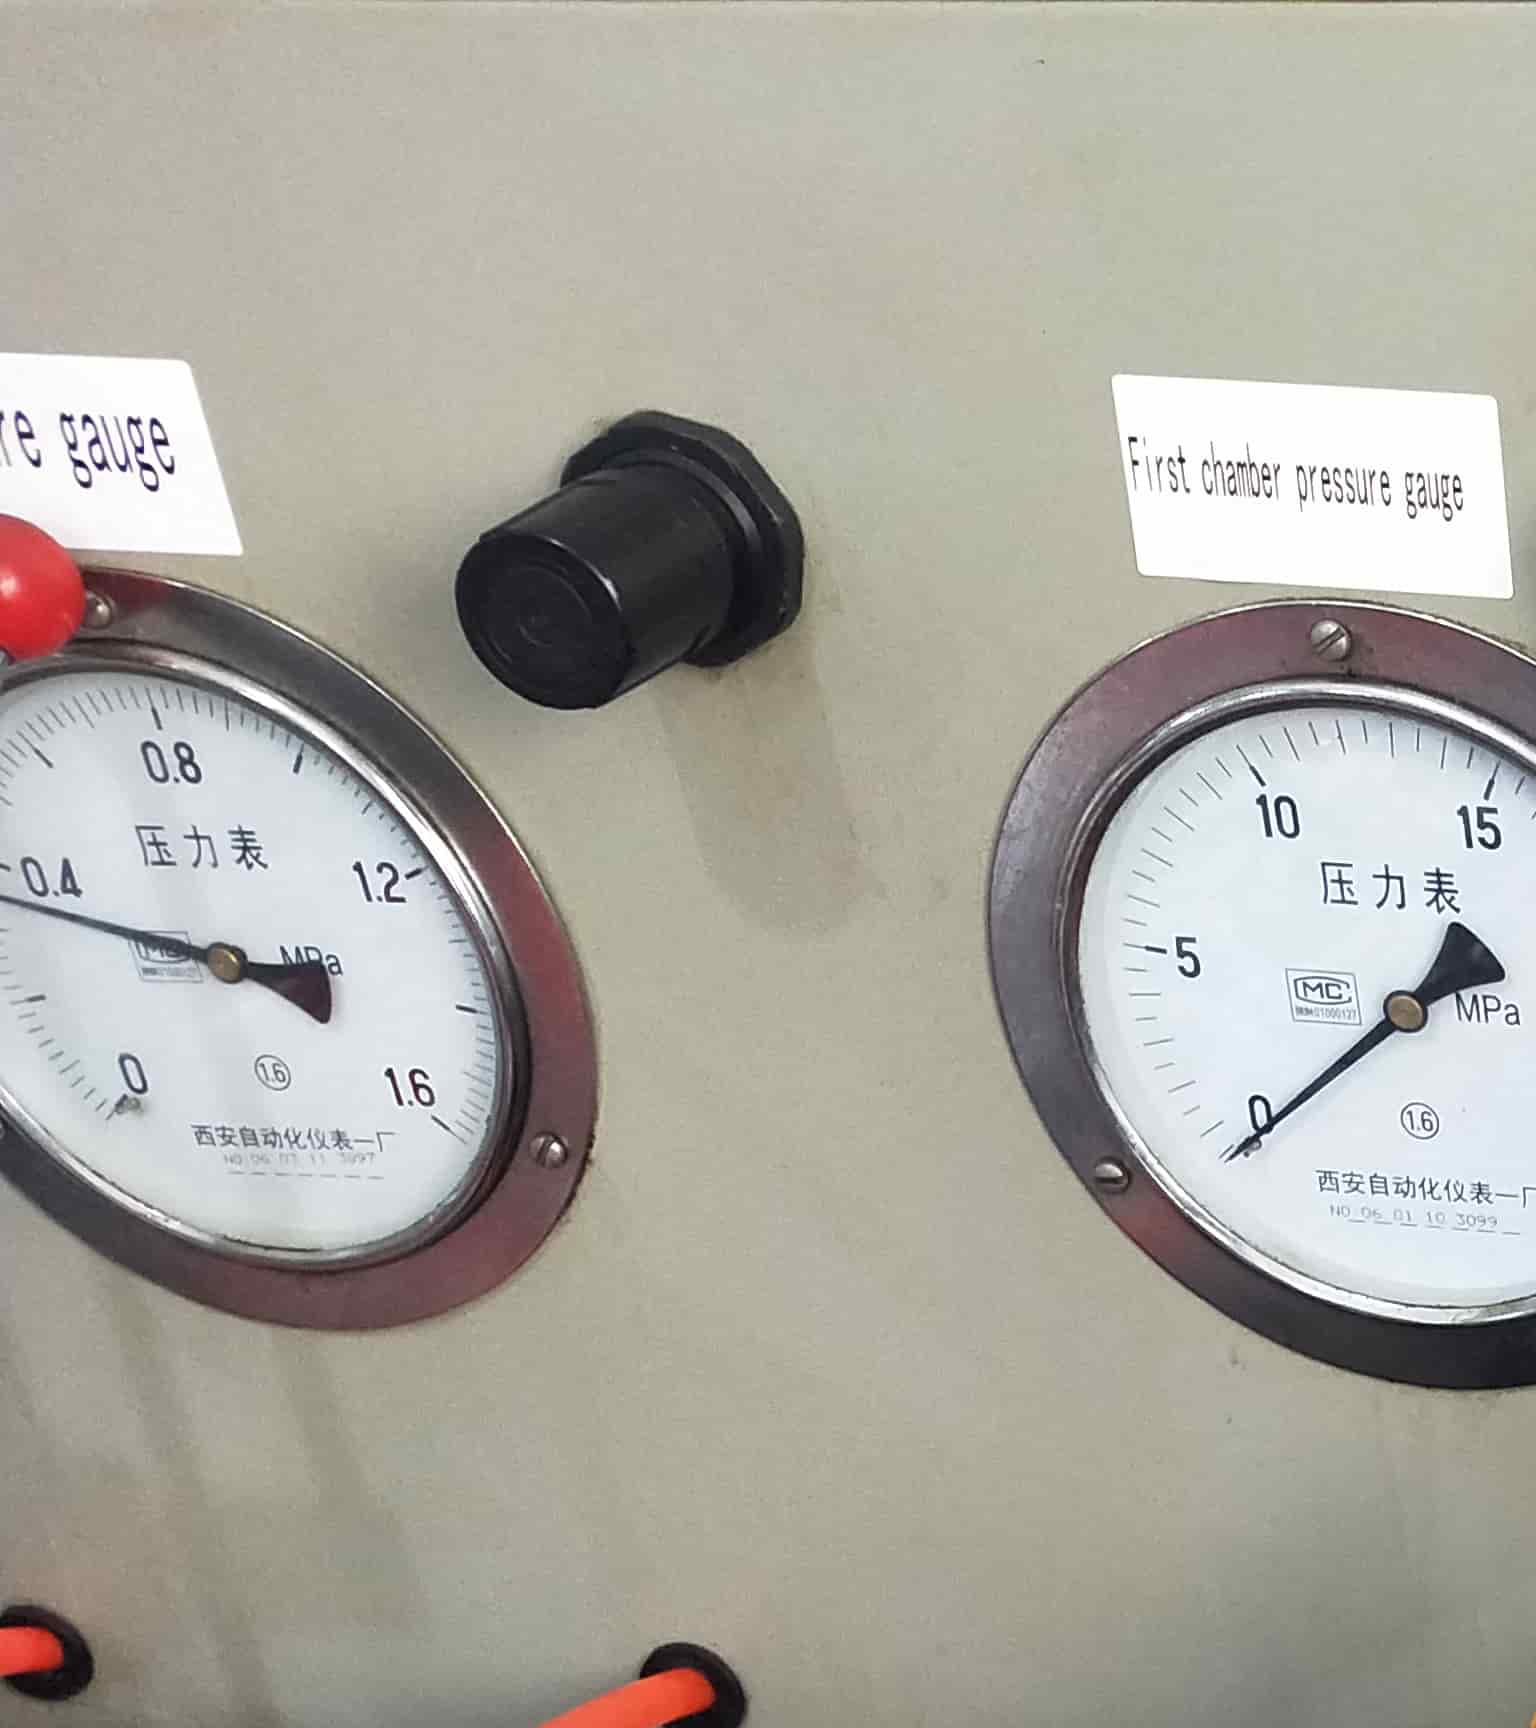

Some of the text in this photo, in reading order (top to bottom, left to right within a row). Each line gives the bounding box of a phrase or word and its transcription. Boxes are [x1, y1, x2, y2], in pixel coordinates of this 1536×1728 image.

[60, 412, 175, 492] gauge
[1128, 436, 1464, 522] First chamber pressure gauge
[143, 740, 203, 784] 0.8
[1255, 795, 1302, 839] 10
[1456, 805, 1502, 850] 15
[135, 824, 270, 871] 压力表
[20, 856, 83, 899] 0.4
[352, 861, 407, 903] 1.2
[1320, 860, 1462, 913] 压力表
[1176, 937, 1201, 978] 5
[1455, 993, 1521, 1026] MPa
[118, 1052, 148, 1095] 0
[259, 1061, 287, 1084] 1.6
[383, 1067, 434, 1109] 1.6
[1246, 1094, 1272, 1138] 0
[1406, 1109, 1433, 1132] 1.6
[191, 1124, 399, 1152] 西安自动化仪表一厂
